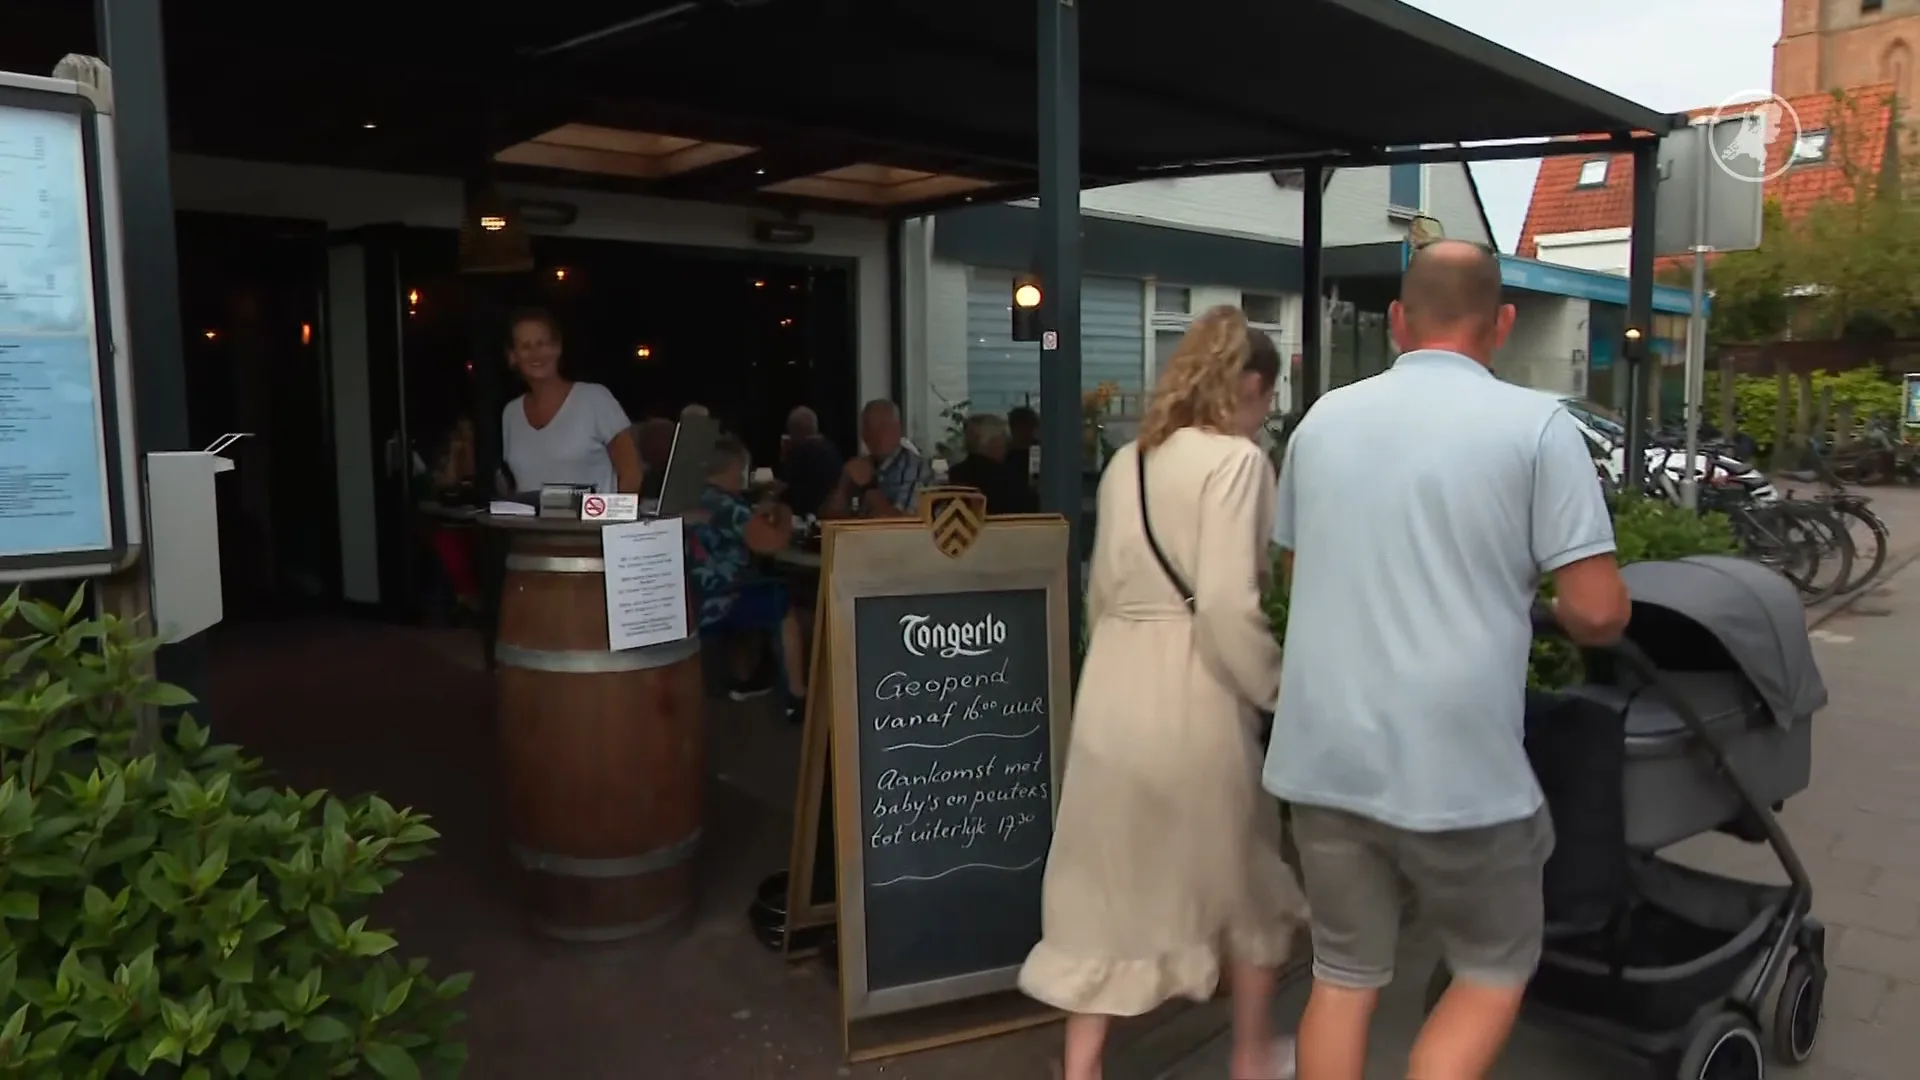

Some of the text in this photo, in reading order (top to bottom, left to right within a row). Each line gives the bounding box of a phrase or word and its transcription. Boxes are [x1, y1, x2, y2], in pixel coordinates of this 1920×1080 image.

[899, 612, 1006, 658] Tongerlo
[875, 657, 1009, 701] Geopend
[873, 701, 958, 732] vanaf
[1004, 752, 1043, 776] met
[873, 790, 940, 826] baby's
[946, 794, 968, 807] en
[871, 823, 904, 849] tot
